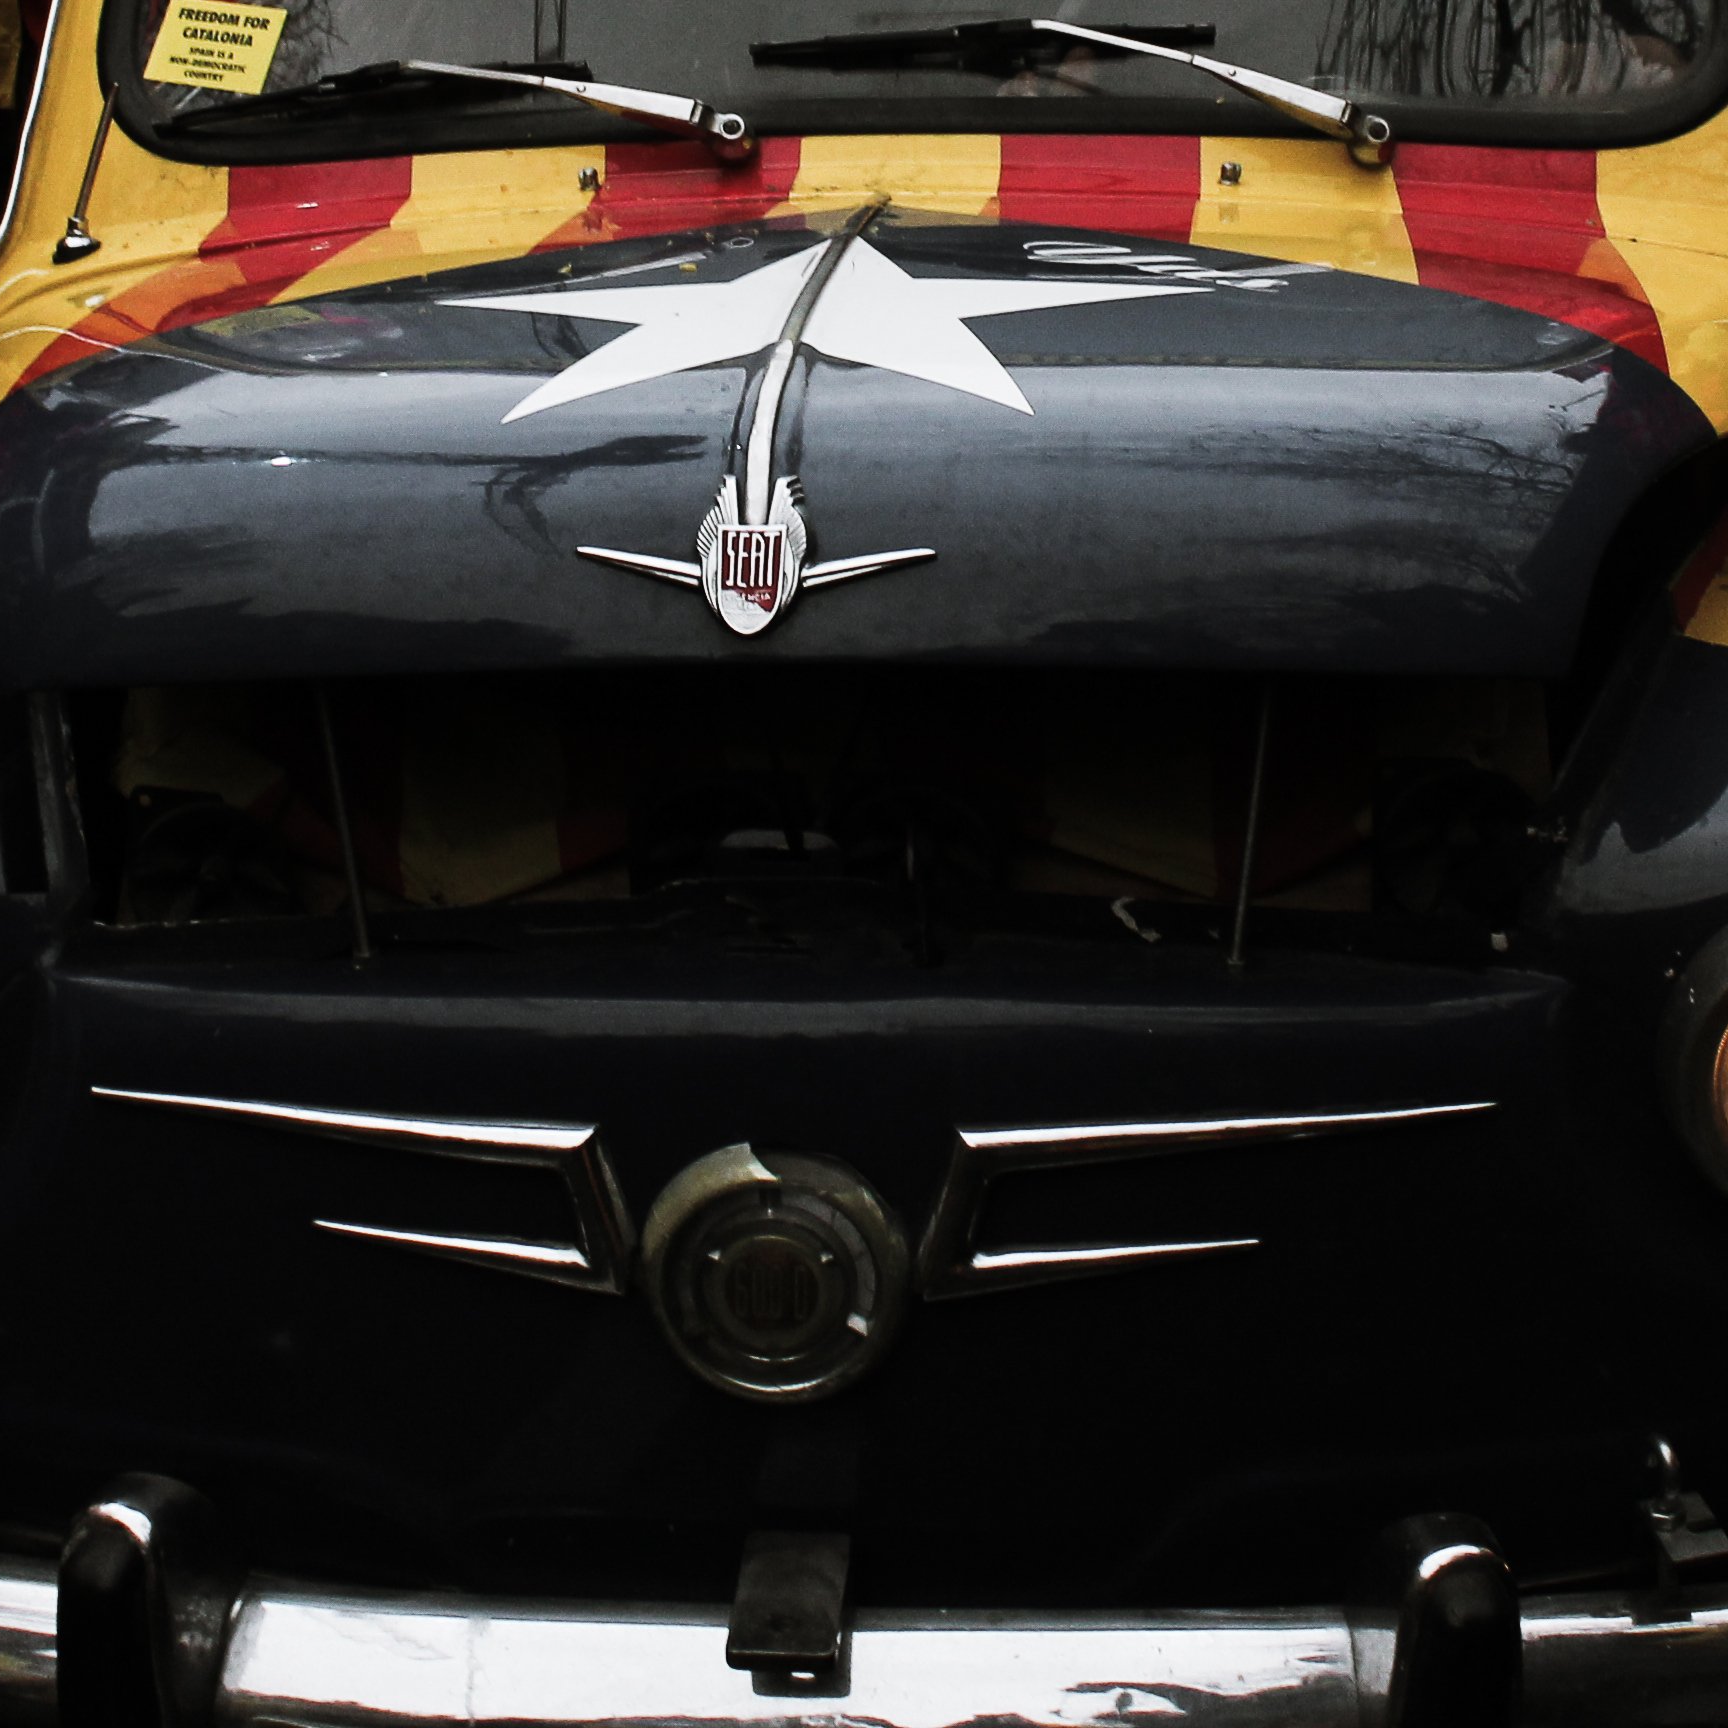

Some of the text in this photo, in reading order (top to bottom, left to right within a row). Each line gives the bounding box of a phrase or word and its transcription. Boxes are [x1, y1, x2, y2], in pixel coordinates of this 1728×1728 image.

[179, 8, 271, 30] FREEDOM FOR
[183, 27, 253, 47] CATALONIA
[725, 531, 781, 589] SEAT
